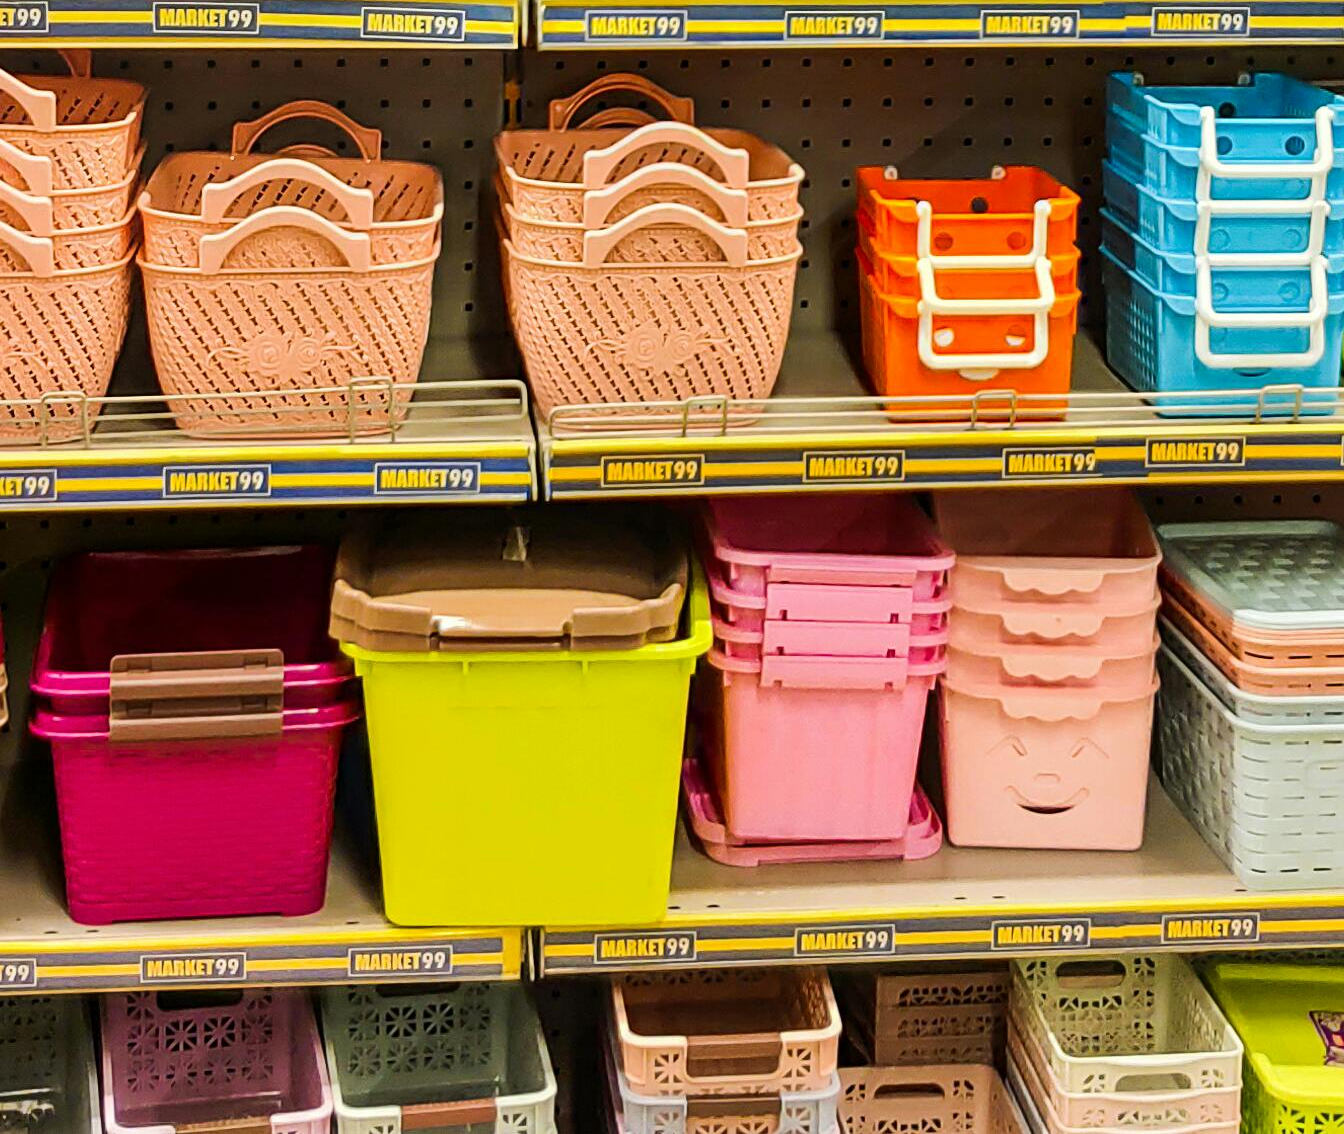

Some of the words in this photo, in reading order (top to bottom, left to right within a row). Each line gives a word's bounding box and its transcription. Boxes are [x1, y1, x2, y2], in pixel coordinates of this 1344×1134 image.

[160, 7, 252, 28] MARKET99
[367, 12, 458, 35] MARKET99
[591, 16, 680, 36] MARKET99
[790, 16, 877, 36] MARKET99
[986, 15, 1072, 35] MARKET99
[1157, 12, 1244, 32] MARKET99
[1151, 442, 1239, 462] MARKET99
[607, 459, 698, 482] MARKET99
[809, 455, 899, 477] MARKET99
[1008, 452, 1096, 473] MARKET99
[170, 470, 264, 491] MARKET99
[381, 468, 474, 489] MARKET99
[998, 925, 1083, 945] MARKET99
[1168, 919, 1253, 939] MARKET99
[601, 938, 690, 958] MARKET99
[801, 931, 888, 952] MARKET99
[147, 959, 240, 979] MARKET99
[355, 951, 446, 973] MARKET99
